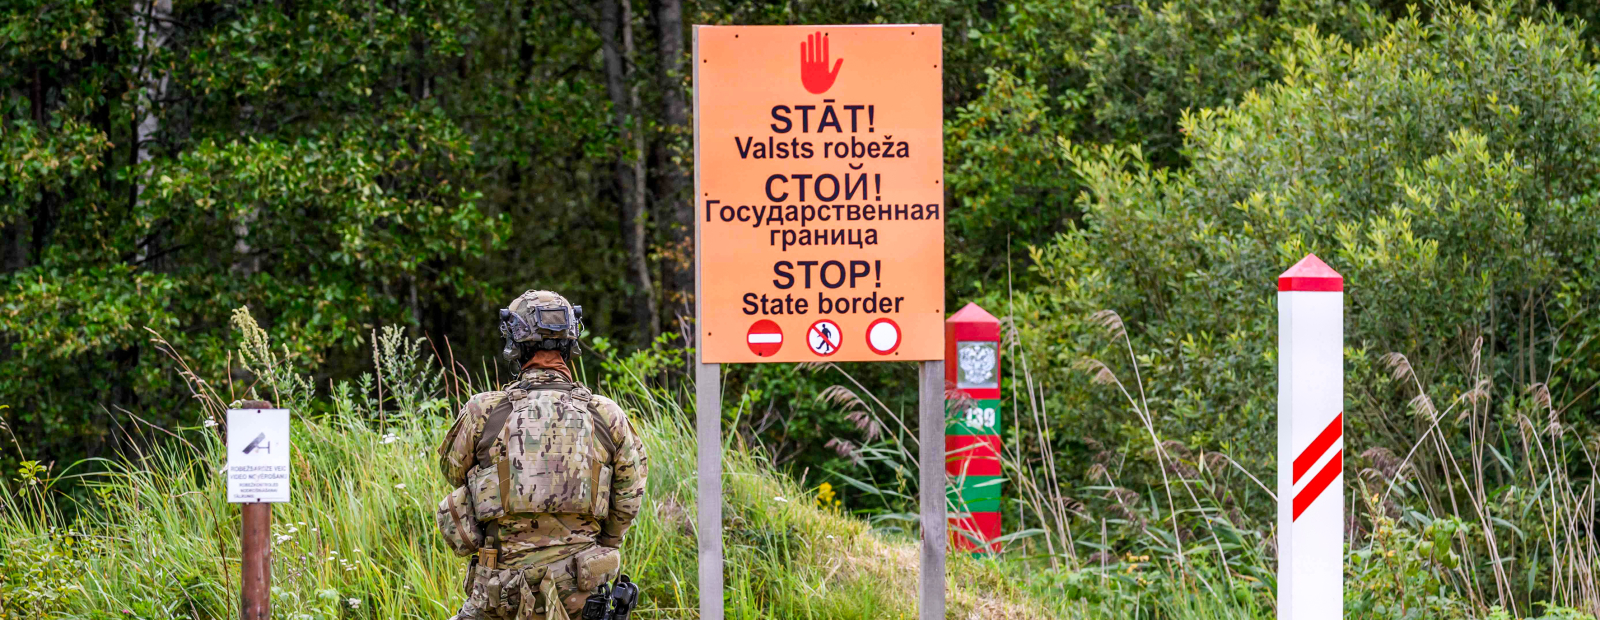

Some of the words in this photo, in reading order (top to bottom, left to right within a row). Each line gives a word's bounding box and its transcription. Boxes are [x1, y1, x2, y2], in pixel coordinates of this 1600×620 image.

[770, 99, 875, 134] STĀT!
[735, 136, 814, 160] Valsts
[824, 135, 910, 159] robeža
[765, 163, 882, 202] СТОЙ!
[705, 200, 940, 228] Государственная
[770, 228, 878, 252] граница
[772, 260, 882, 290] STOP!
[742, 293, 809, 316] State
[818, 292, 905, 315] border
